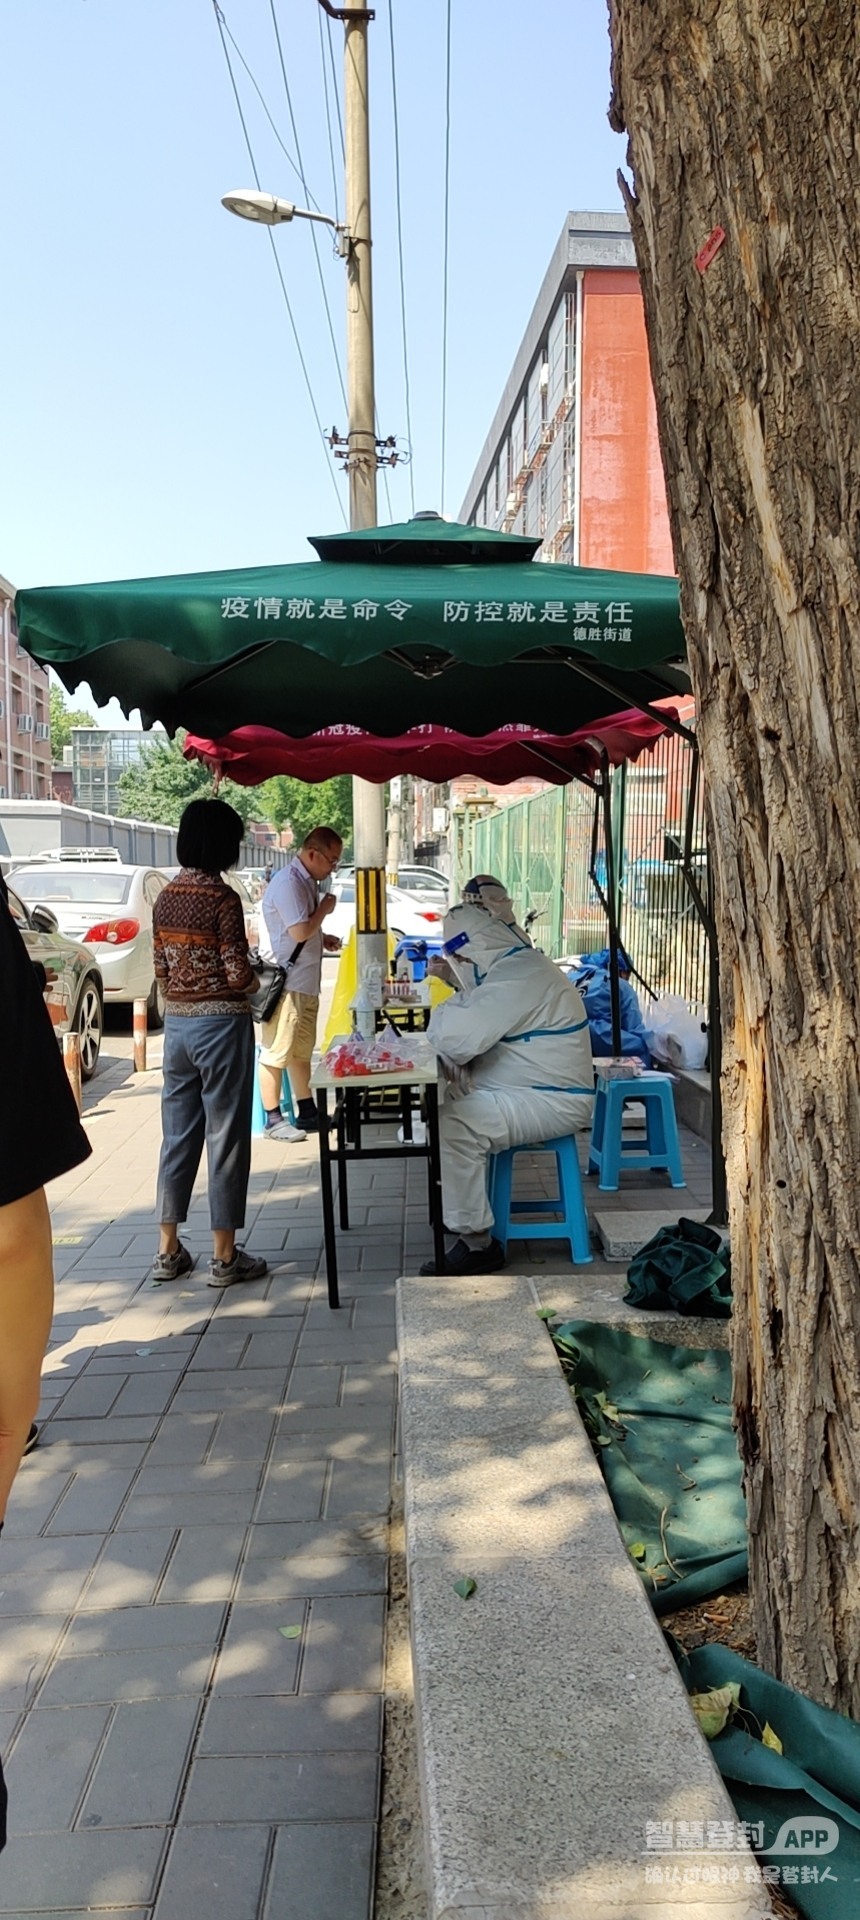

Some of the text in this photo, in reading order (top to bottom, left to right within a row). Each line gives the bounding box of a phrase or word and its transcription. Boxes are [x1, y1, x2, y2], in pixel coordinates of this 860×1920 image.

[221, 596, 634, 624] 疫情就是命令 防控就是责任
[573, 626, 632, 642] 德胜街道
